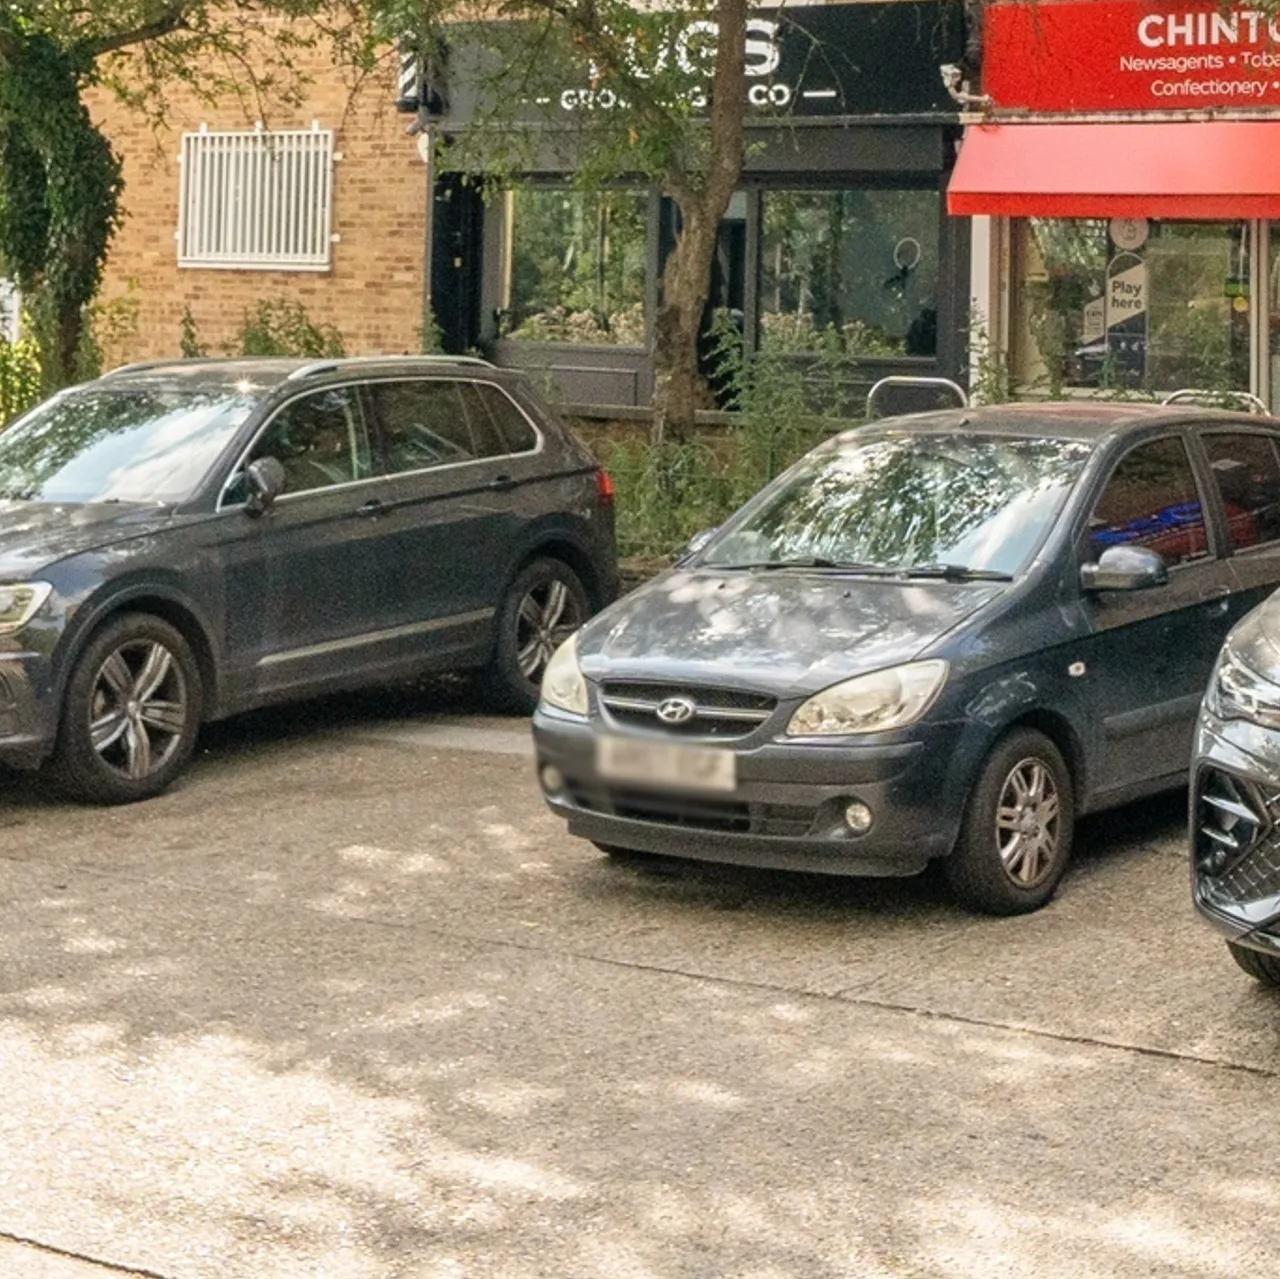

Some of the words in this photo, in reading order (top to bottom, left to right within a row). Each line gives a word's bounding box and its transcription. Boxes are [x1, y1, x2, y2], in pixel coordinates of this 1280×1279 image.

[1119, 51, 1224, 74] Newsagents
[748, 84, 791, 106] CO
[1151, 76, 1268, 99] Confectionery
[1111, 280, 1142, 298] Play
[1111, 296, 1142, 309] here
